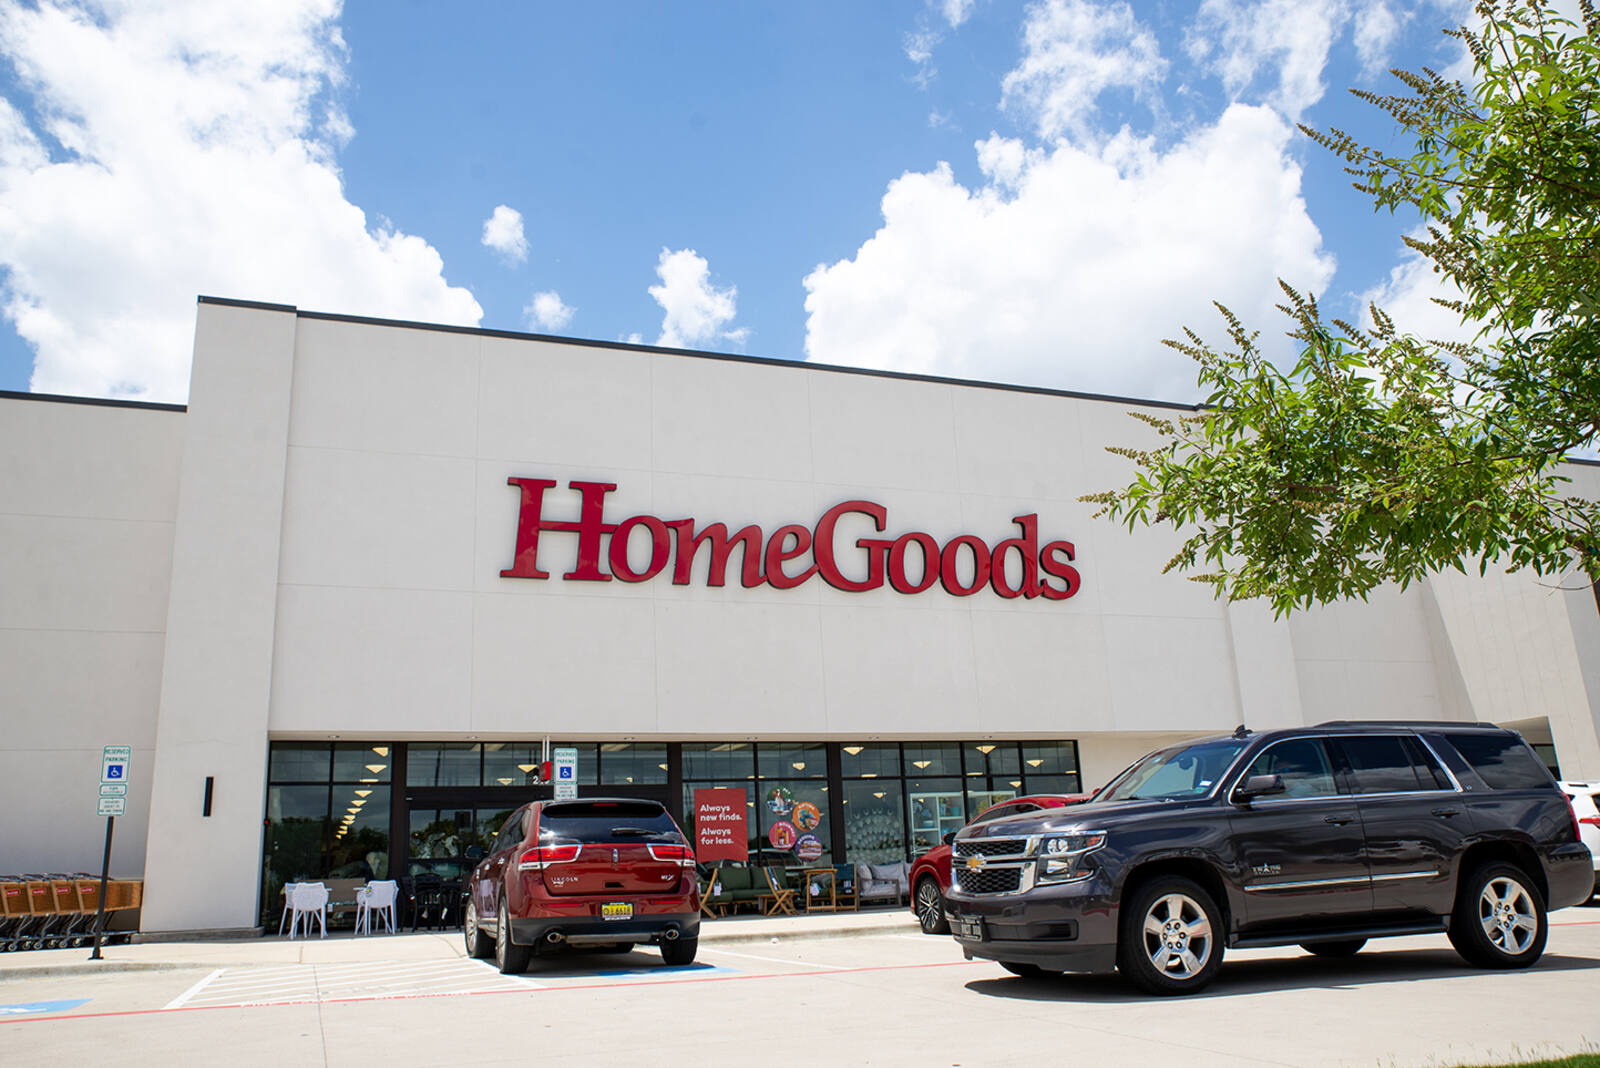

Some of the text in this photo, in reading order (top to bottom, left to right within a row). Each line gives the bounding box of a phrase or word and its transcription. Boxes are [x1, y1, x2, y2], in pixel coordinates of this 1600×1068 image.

[499, 477, 1081, 600] HomeGoods
[700, 804, 730, 814] Always
[719, 813, 742, 821] finds.
[701, 827, 731, 837] Always
[701, 836, 734, 845] for less.
